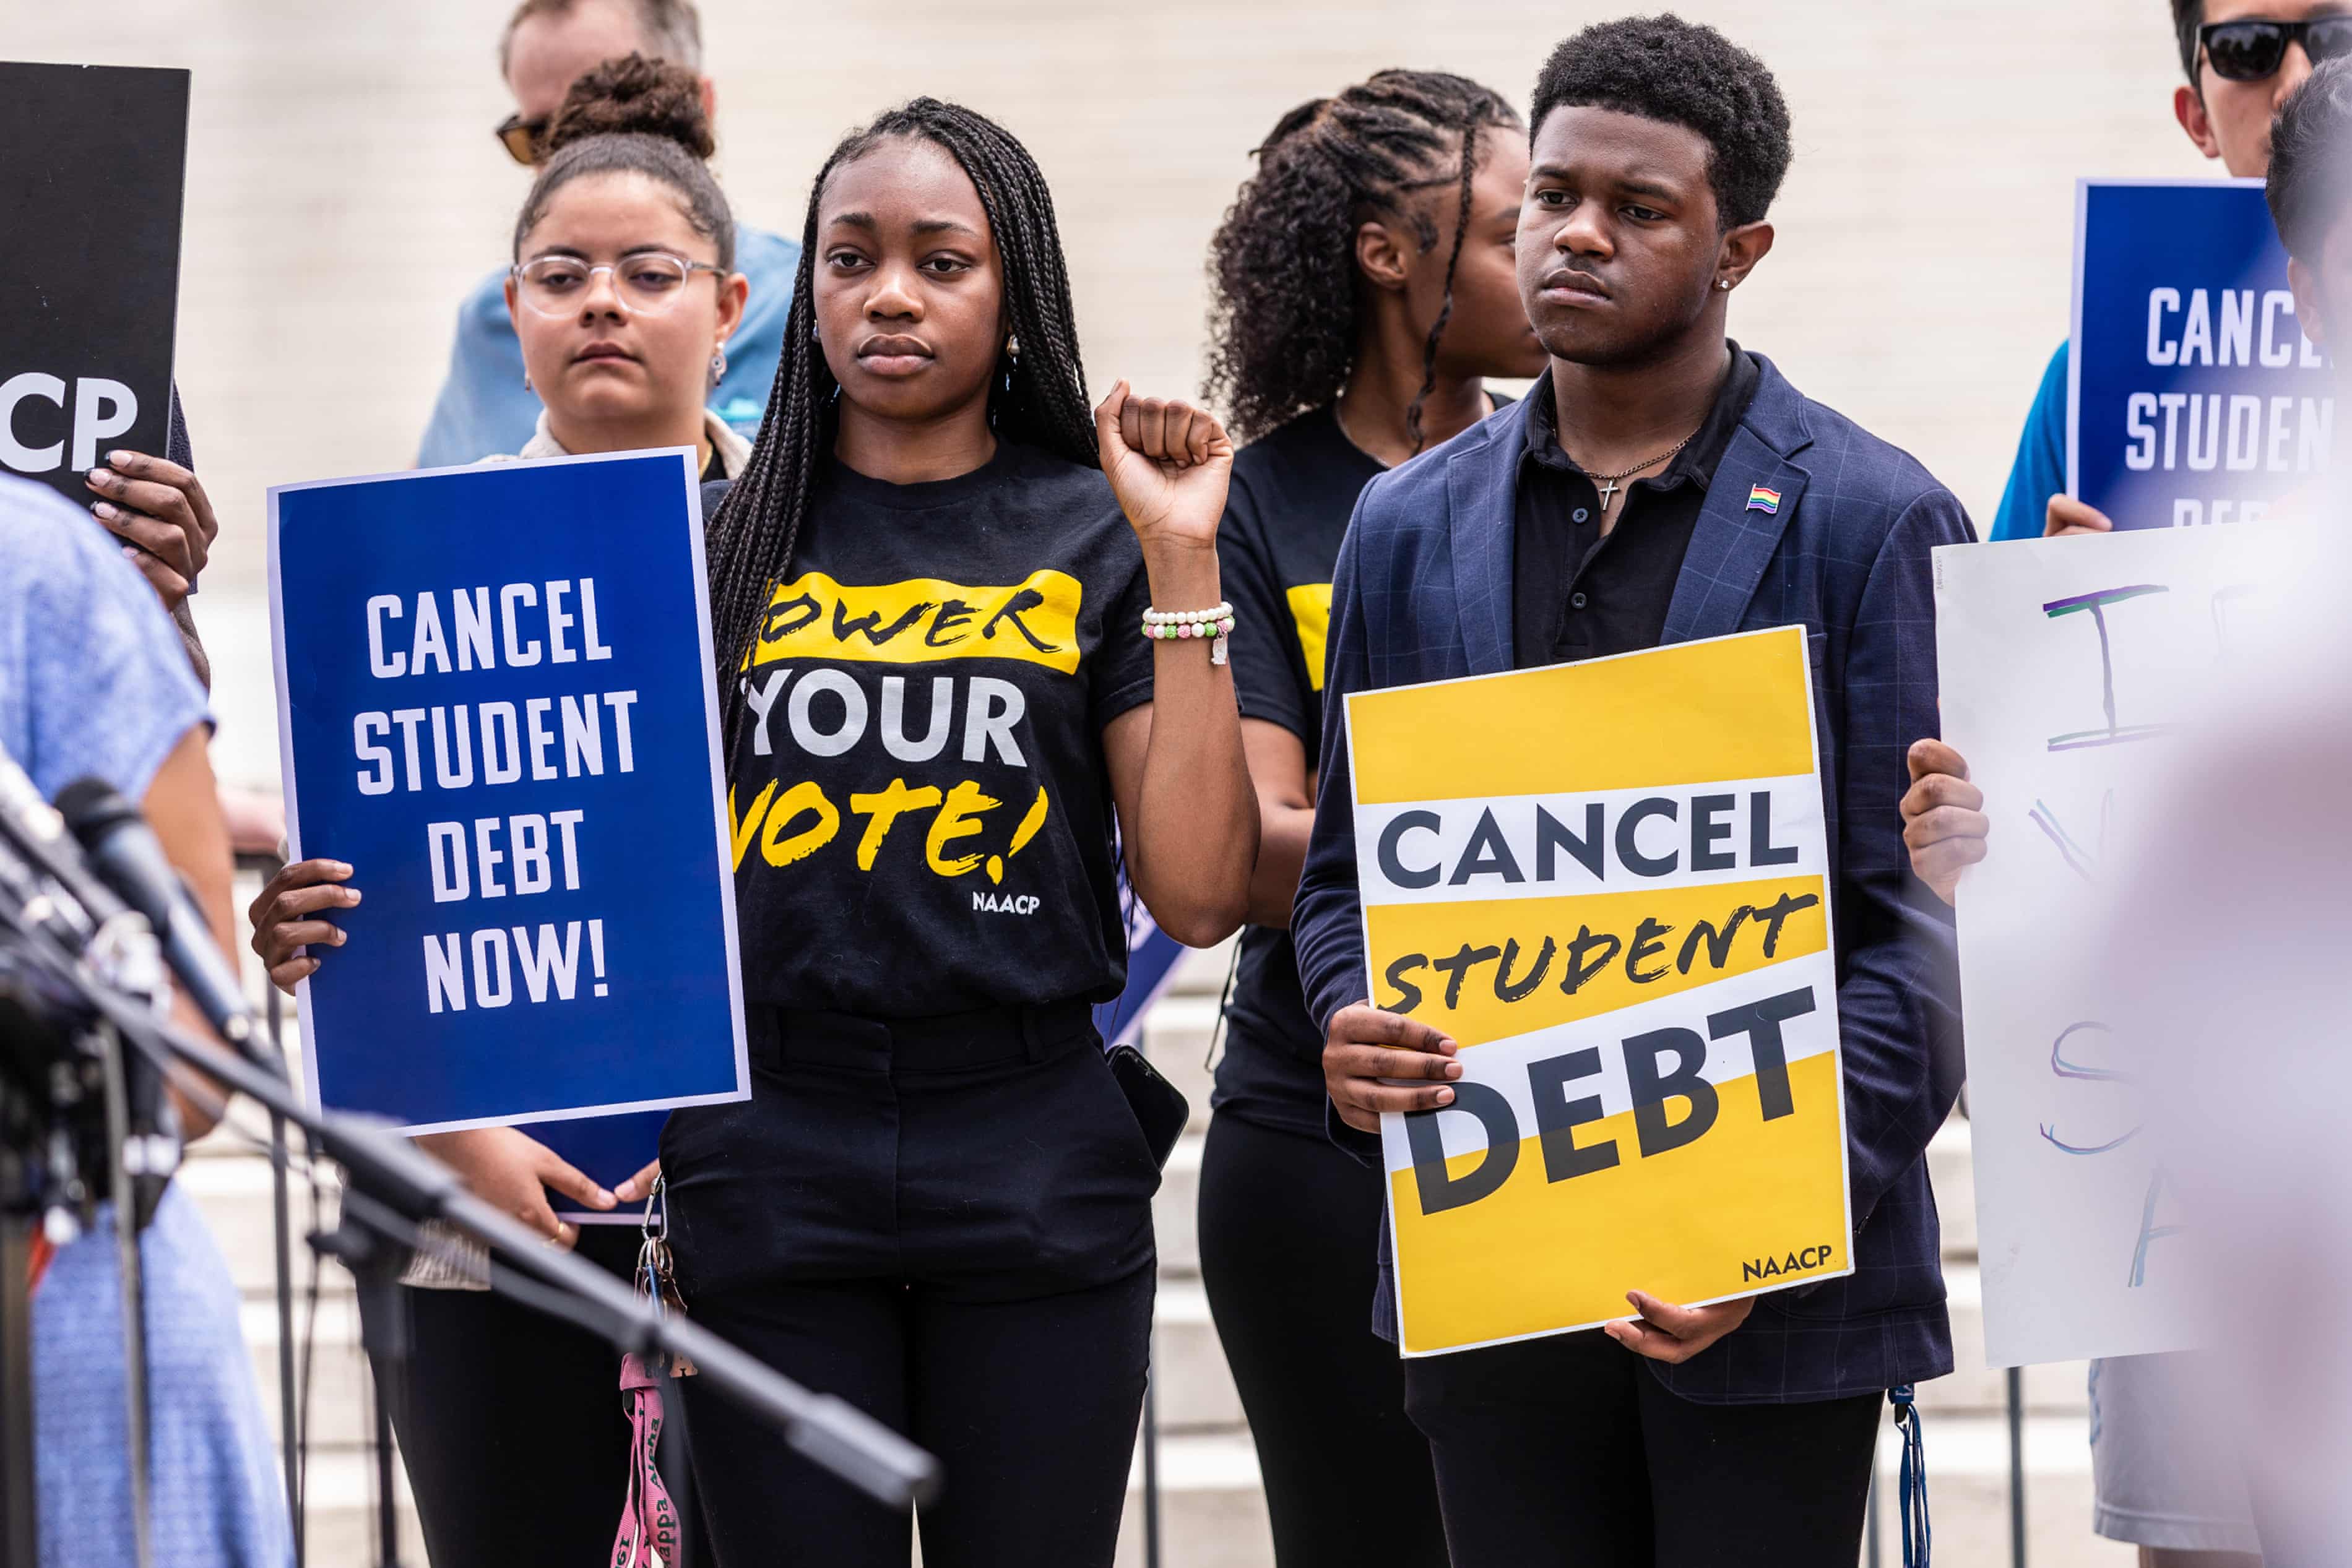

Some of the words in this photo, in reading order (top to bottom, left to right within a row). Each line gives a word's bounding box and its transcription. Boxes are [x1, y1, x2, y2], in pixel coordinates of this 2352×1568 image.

[2147, 287, 2335, 370] CANC
[2125, 392, 2335, 472] STUDEN
[367, 578, 612, 679] CANCEL
[761, 588, 1062, 653] OWER
[353, 690, 638, 796] STUDENT
[740, 668, 1027, 767] YOUR
[427, 809, 584, 903] DEBT
[728, 778, 1049, 885] VOTE!
[1377, 791, 1799, 889] CANCEL
[972, 892, 1040, 915] NAACP
[423, 919, 608, 1014] NOW!
[1377, 892, 1818, 1015] STUDENT
[1404, 985, 1817, 1215] DEBT
[1742, 1245, 1833, 1283] NAACP
